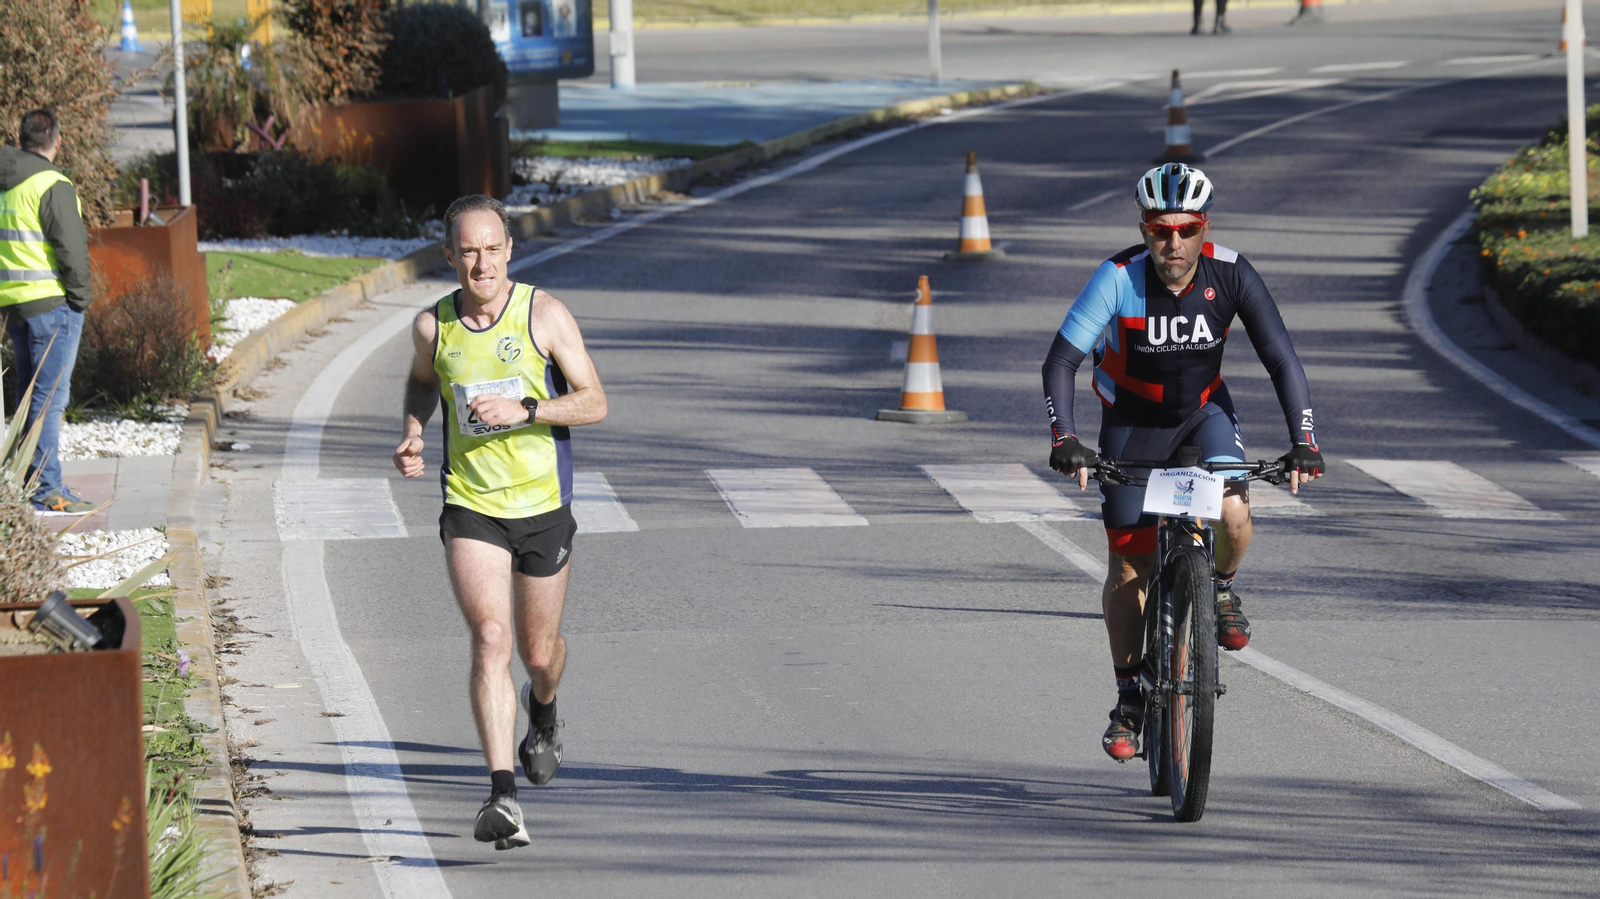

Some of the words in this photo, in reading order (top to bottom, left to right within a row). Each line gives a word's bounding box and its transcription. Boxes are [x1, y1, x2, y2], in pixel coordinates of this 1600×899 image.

[1148, 314, 1214, 345] UCA
[1135, 344, 1155, 353] UNIÓN
[1157, 344, 1184, 353] CICLISTA
[1301, 409, 1314, 431] UCA
